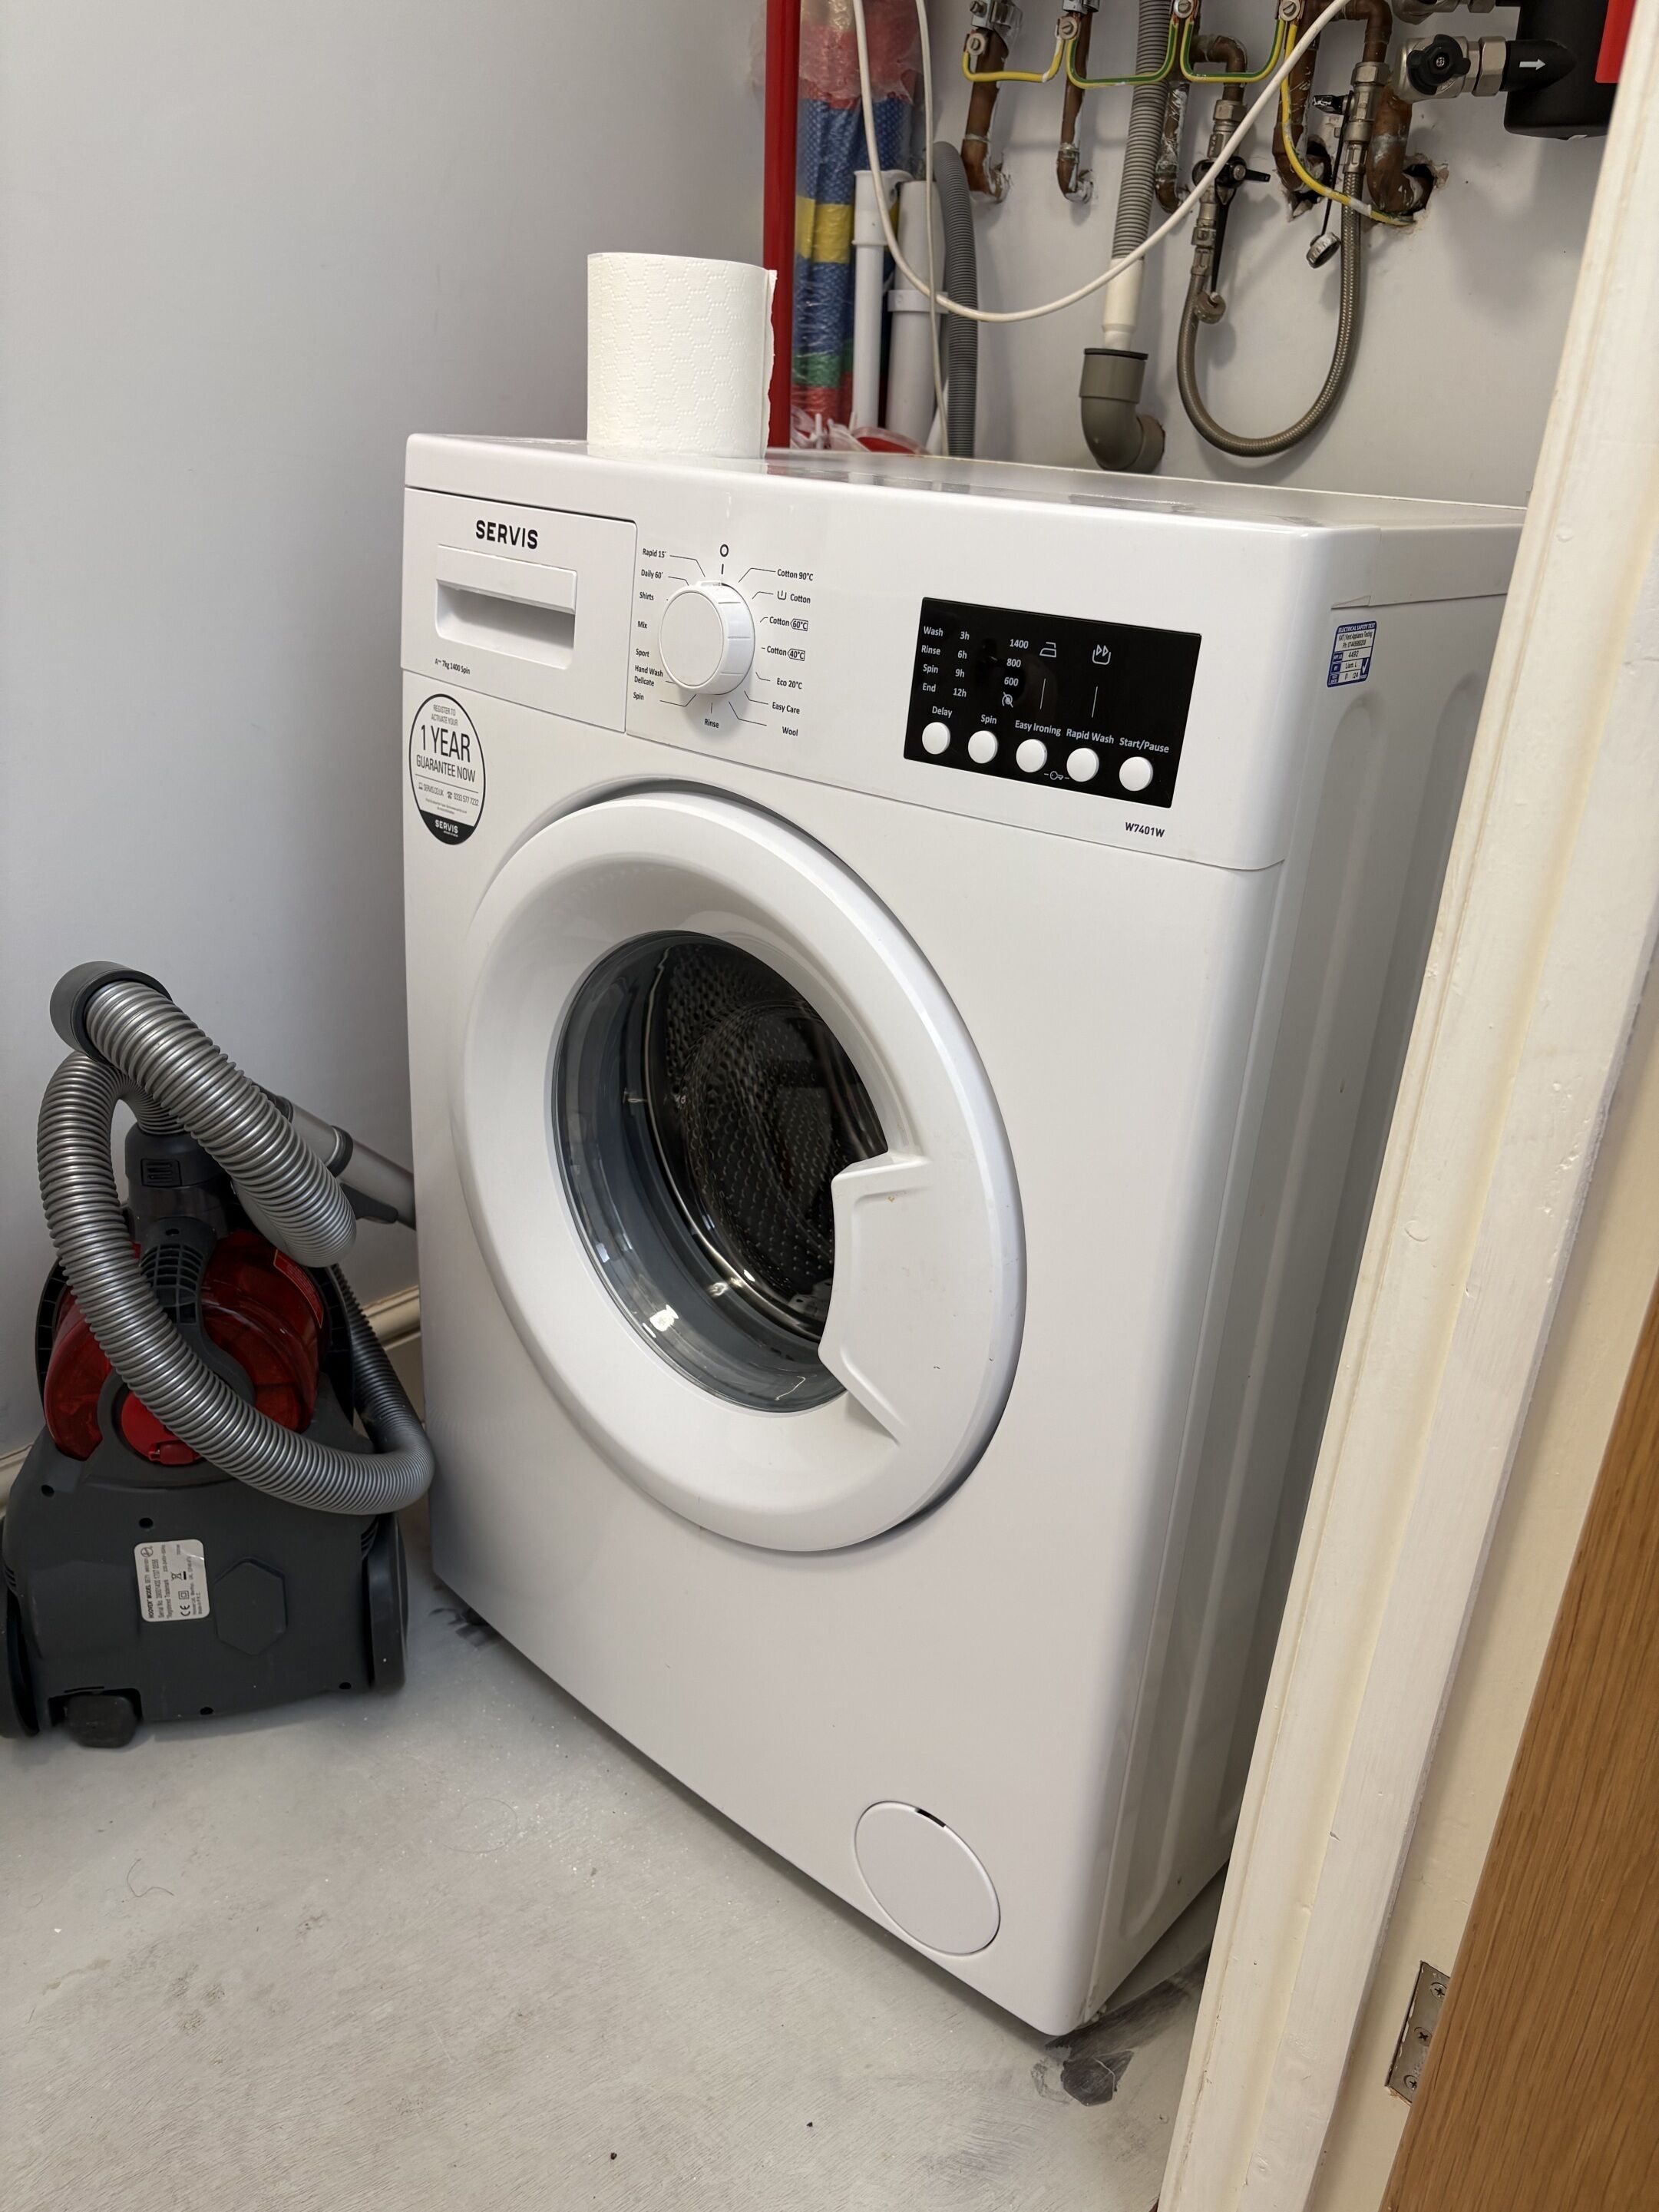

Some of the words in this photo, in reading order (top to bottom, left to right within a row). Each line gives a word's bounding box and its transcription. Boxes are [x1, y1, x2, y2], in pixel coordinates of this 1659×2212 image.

[476, 520, 538, 549] SERVIS
[642, 548, 657, 558] Rapid
[641, 569, 654, 579] Daily
[777, 569, 798, 579] Cotton
[798, 572, 813, 581] 90°C
[639, 592, 654, 601] Shirts
[790, 594, 811, 604] Cotton
[638, 621, 648, 629] Mix
[769, 616, 790, 627] Cotton
[792, 620, 808, 630] 60°C
[924, 626, 944, 636] Wash
[960, 631, 970, 640] 3h
[1009, 638, 1029, 650] 1400
[636, 648, 649, 658] Sport
[767, 646, 787, 656] Cotton
[789, 650, 805, 660] 40°C
[921, 645, 941, 655] Rinse
[957, 650, 968, 660] 6h
[450, 662, 461, 672] 1400
[461, 665, 470, 675] Spin
[922, 663, 939, 674] Spin
[1006, 658, 1022, 668] 800
[635, 665, 648, 674] Hand
[648, 668, 664, 677] Wash
[955, 668, 965, 678] 9h
[634, 676, 655, 687] Delicate
[776, 678, 787, 687] Eco
[788, 681, 803, 689] 20°C
[1004, 676, 1019, 687] 600
[922, 682, 937, 693] End
[953, 687, 967, 698] 12h
[633, 692, 644, 701] Spin
[433, 704, 450, 715] REGISTER
[451, 708, 456, 716] TO
[772, 702, 785, 713] Easy
[786, 705, 800, 714] Care
[932, 706, 953, 719] Delay
[431, 713, 448, 724] ACTIVATE
[448, 717, 458, 726] YOUR
[704, 718, 719, 728] Rinse
[981, 714, 997, 725] Spin
[782, 726, 798, 737] Wool
[1015, 719, 1033, 732] Easy
[1033, 722, 1062, 737] Ironing
[1066, 728, 1090, 741] Rapid
[1091, 732, 1115, 744] Wash
[421, 724, 426, 751] 1
[430, 725, 471, 763] YEAR
[1119, 737, 1170, 754] Start/Pause
[416, 754, 456, 777] GUARANTEE
[457, 765, 476, 783] NOW
[435, 819, 458, 834] SERVIS
[1125, 822, 1165, 838] W7401W
